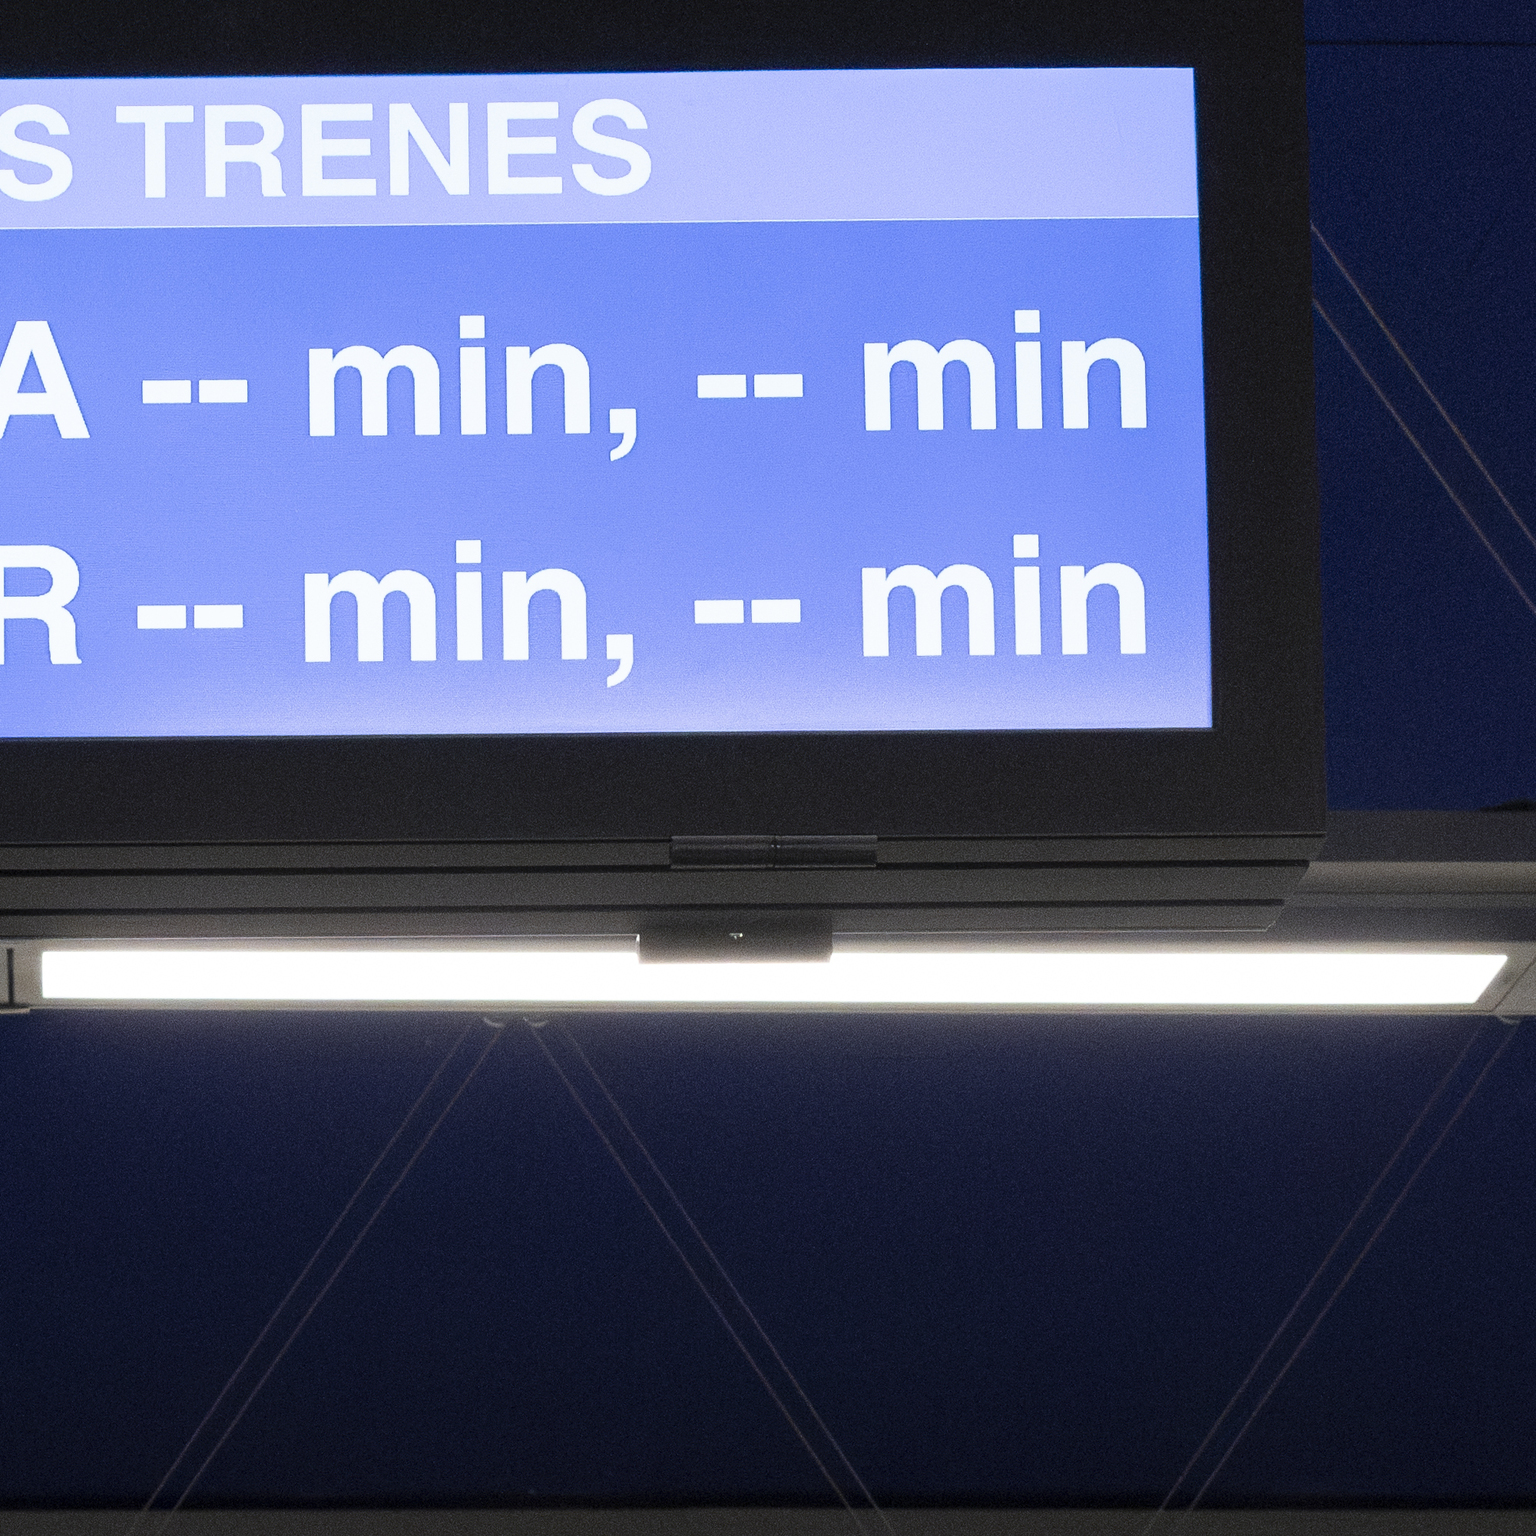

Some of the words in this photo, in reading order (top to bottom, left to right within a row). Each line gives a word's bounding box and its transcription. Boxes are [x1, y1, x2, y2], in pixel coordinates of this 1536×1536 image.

[116, 98, 652, 198] TRENES
[308, 315, 637, 461] min,
[863, 309, 1147, 432] min
[304, 539, 634, 688] min,
[861, 534, 1147, 658] min
